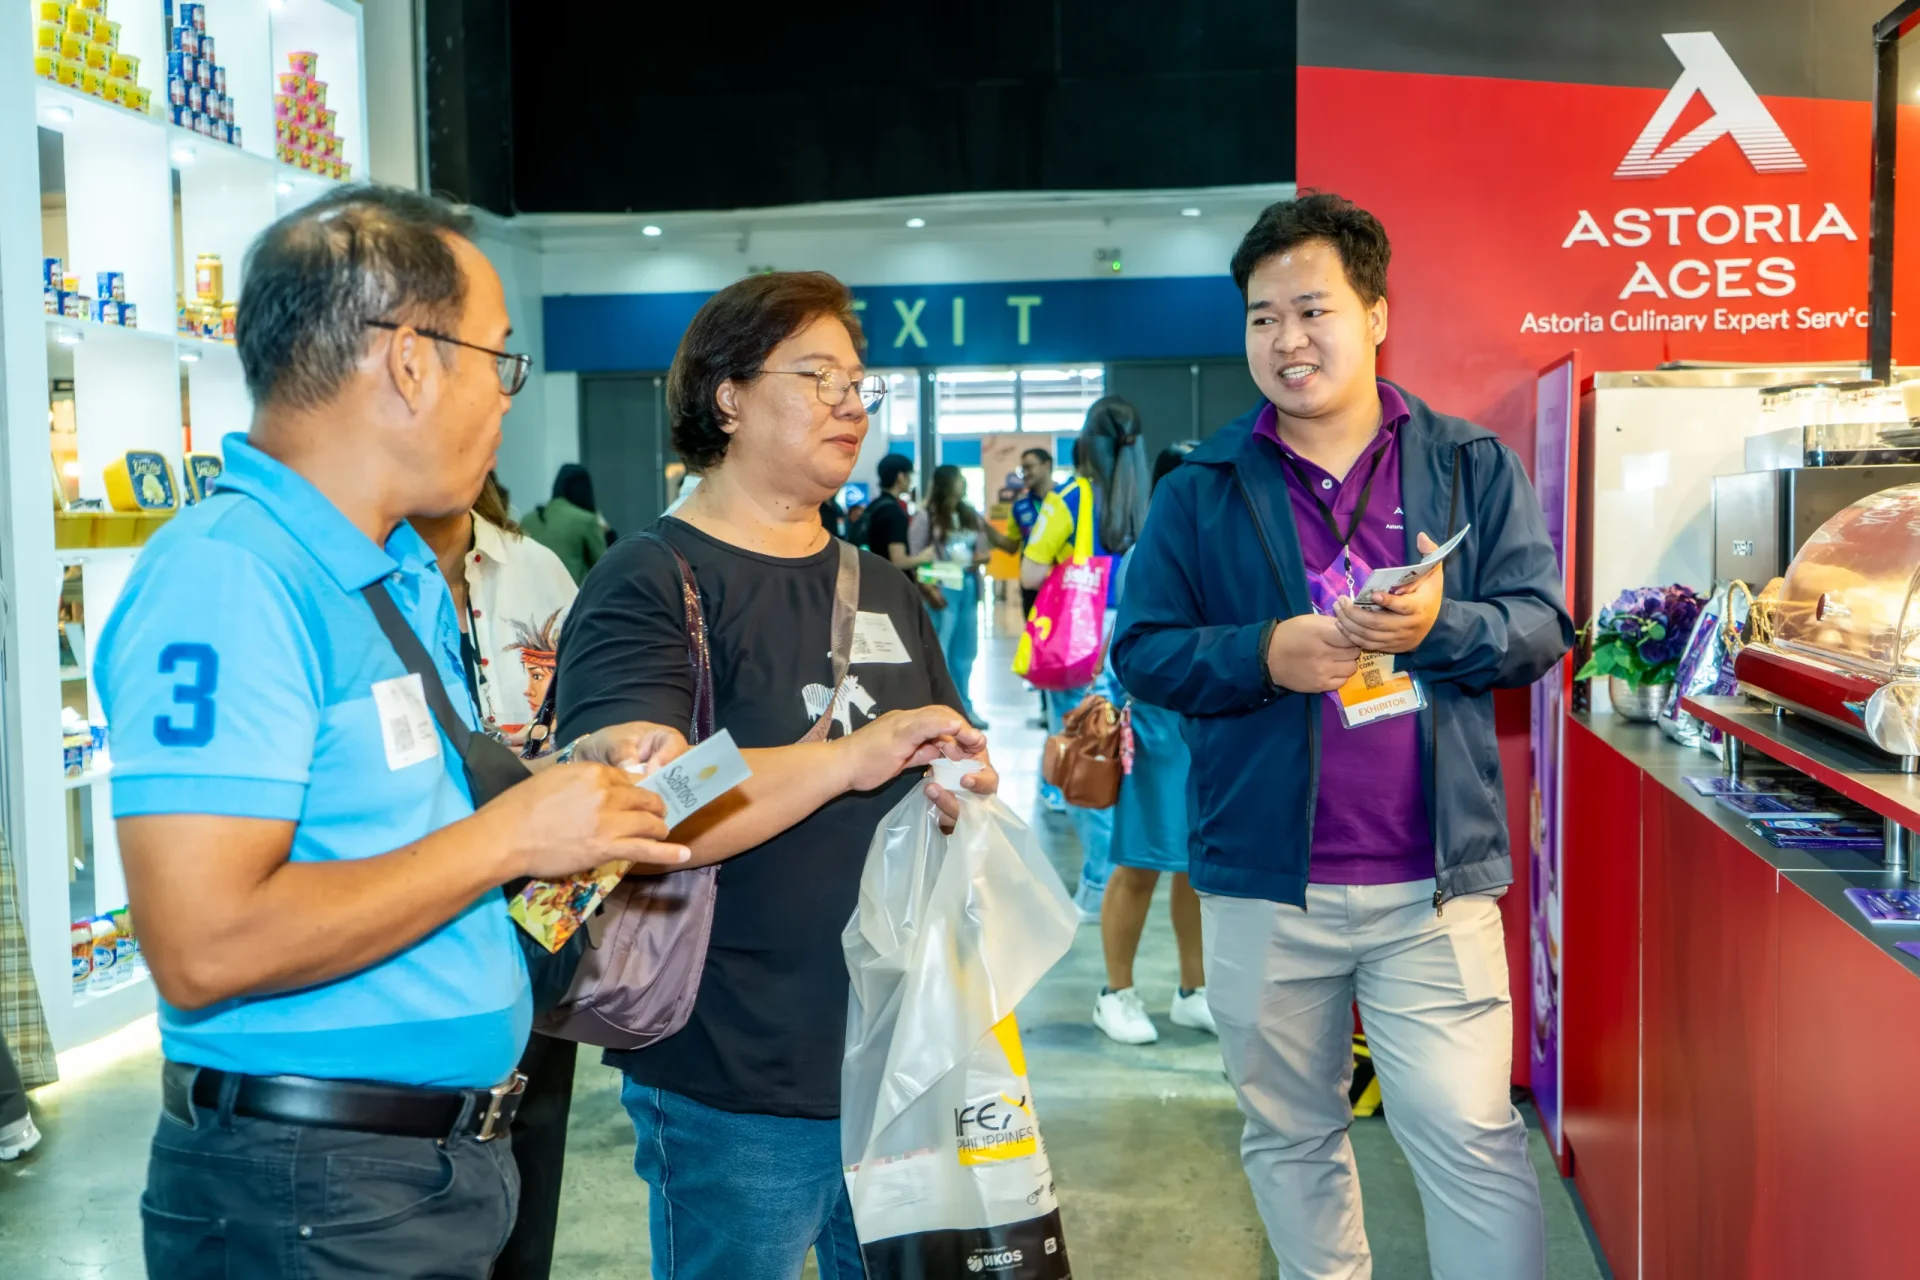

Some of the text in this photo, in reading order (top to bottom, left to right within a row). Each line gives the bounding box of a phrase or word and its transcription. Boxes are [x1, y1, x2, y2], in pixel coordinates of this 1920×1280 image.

[1562, 203, 1858, 248] ASTORIA
[1618, 257, 1797, 300] ACES
[1520, 312, 1604, 334] Astoria
[1610, 309, 1708, 333] Culinary
[1714, 308, 1790, 335] Expert
[154, 642, 219, 748] 3
[1358, 697, 1407, 717] EXHIBITOR
[957, 1125, 1035, 1154] PHILIPPINES
[983, 1249, 1023, 1267] OIKOS
